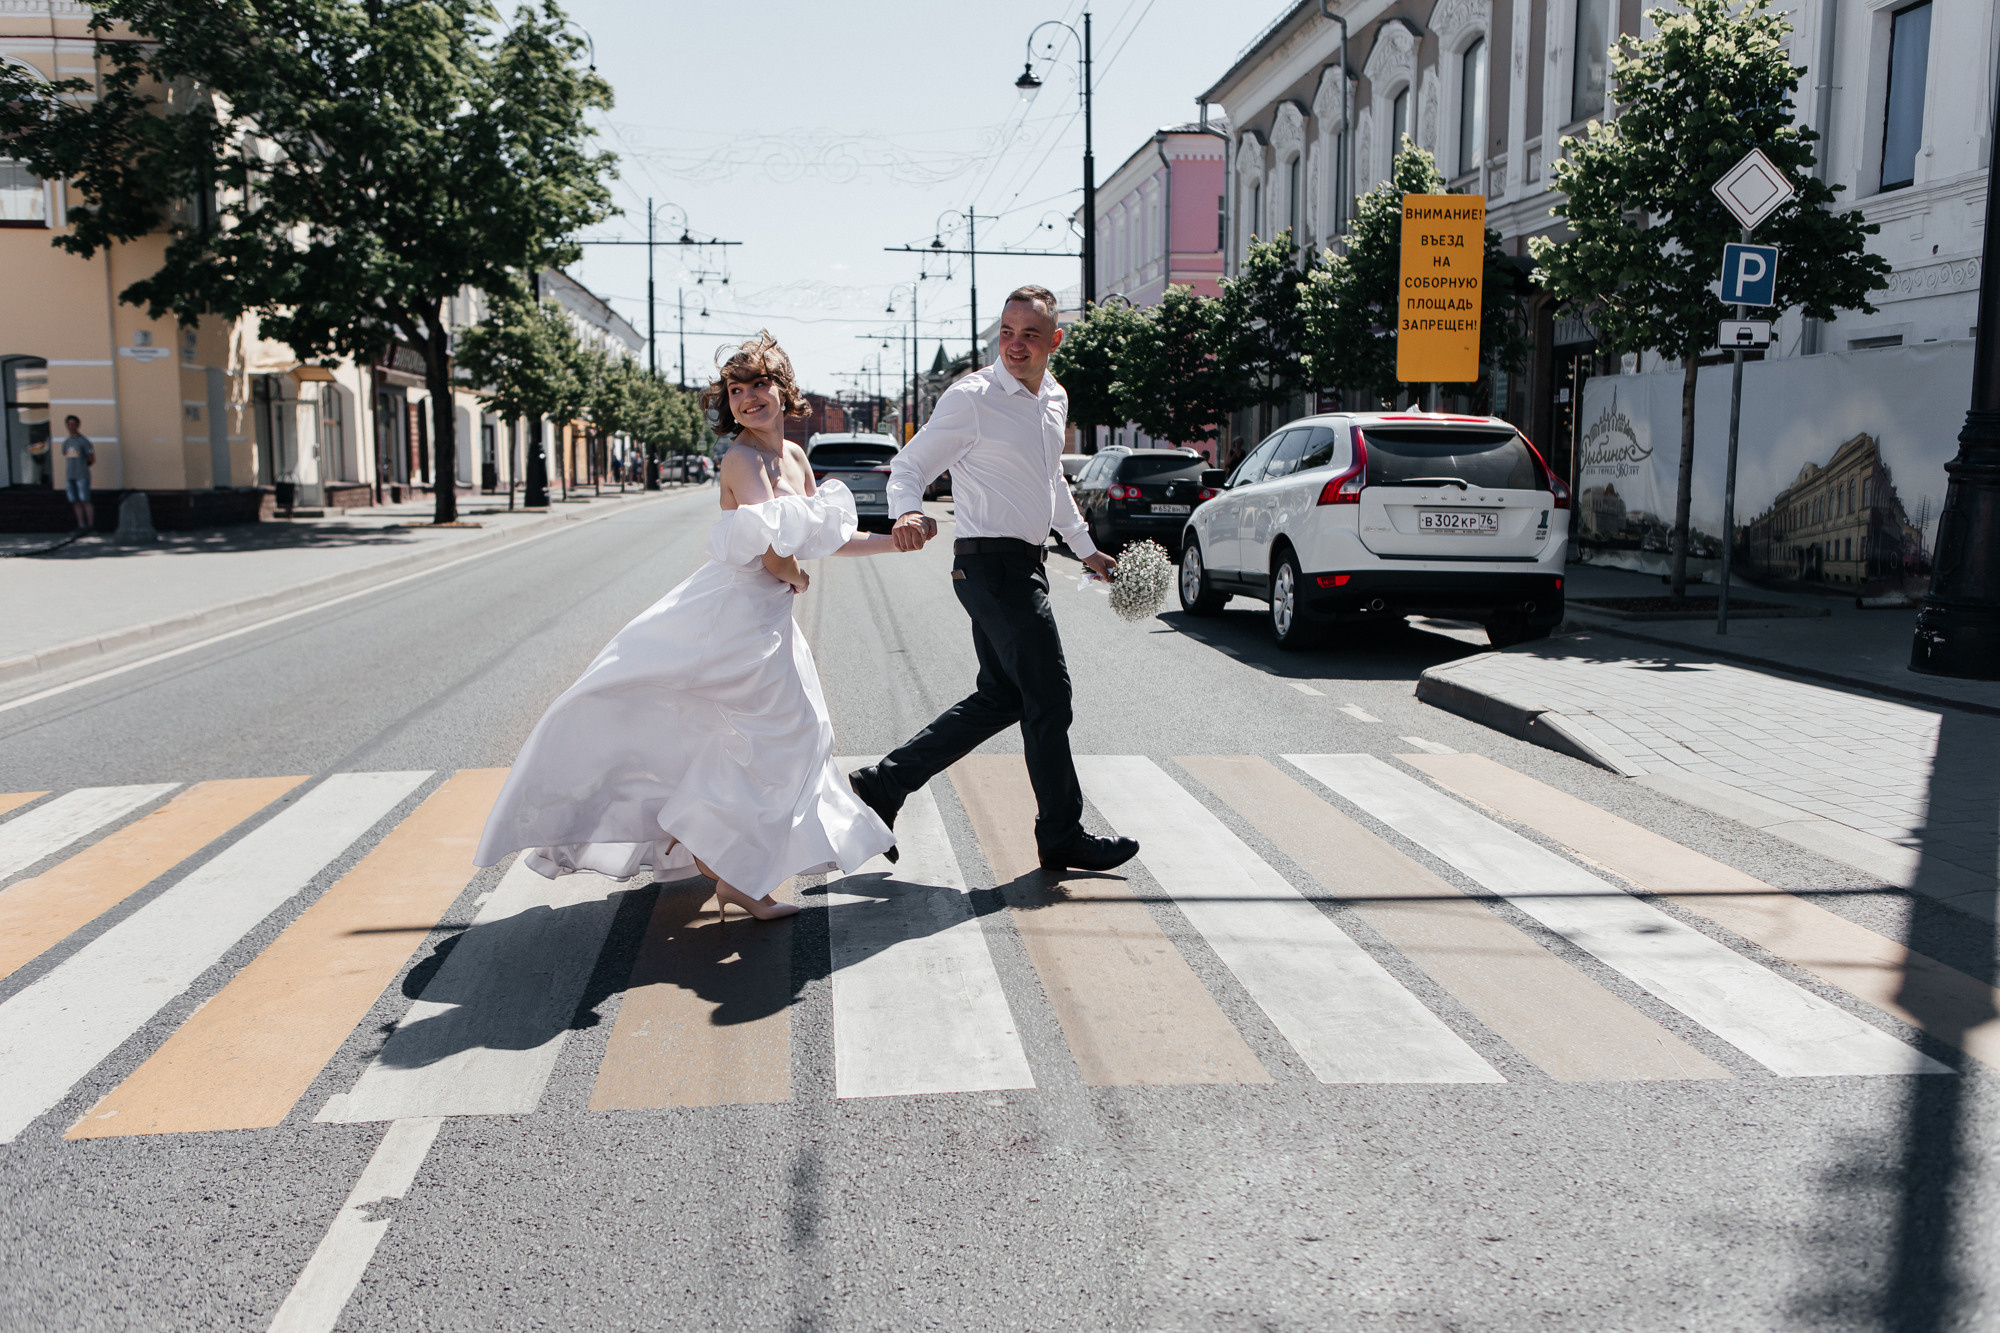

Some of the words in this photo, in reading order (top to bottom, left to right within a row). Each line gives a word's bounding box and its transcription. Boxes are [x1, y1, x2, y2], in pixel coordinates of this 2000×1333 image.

[1405, 208, 1482, 220] ВНИМАНИЕ!
[1421, 235, 1464, 248] ВЪЕЗД
[1433, 256, 1451, 267] НА
[1736, 252, 1766, 297] P
[1404, 277, 1478, 289] СОБОРНУЮ
[1407, 298, 1473, 311] ПЛОЩАДЬ
[1402, 319, 1477, 332] ЗАПРЕЩЕН!
